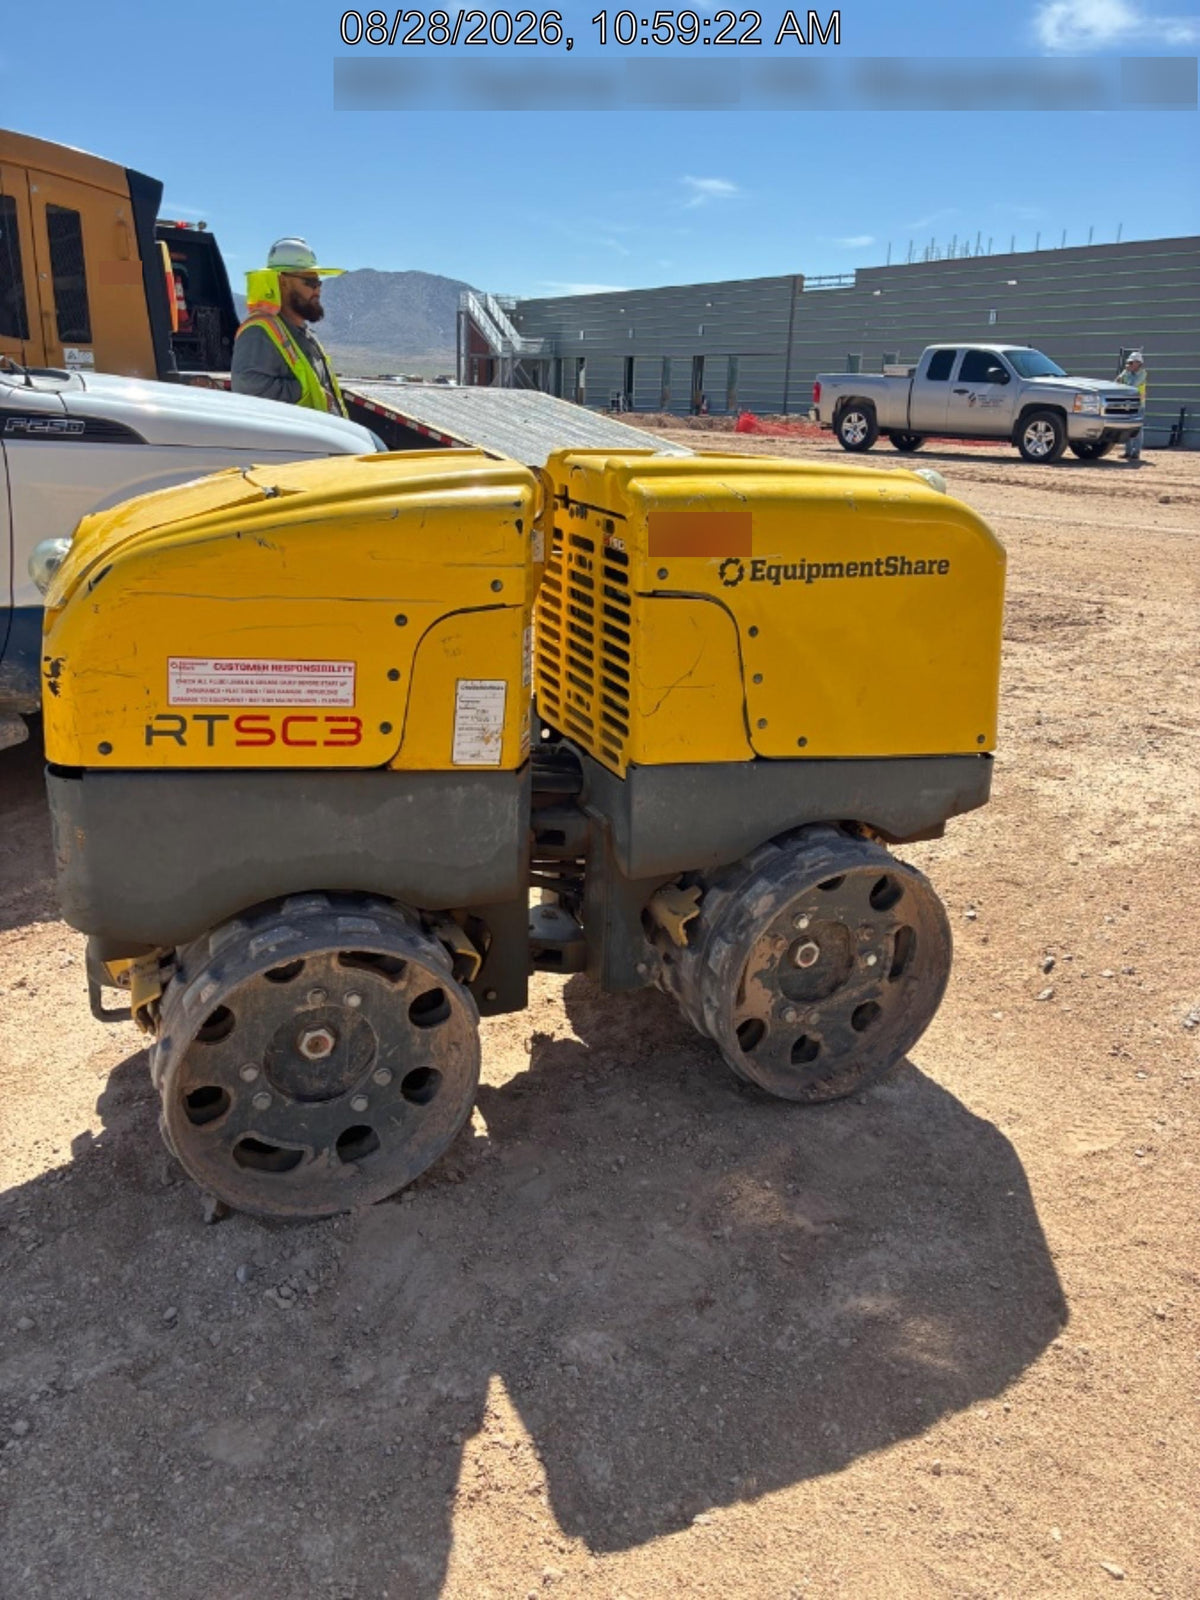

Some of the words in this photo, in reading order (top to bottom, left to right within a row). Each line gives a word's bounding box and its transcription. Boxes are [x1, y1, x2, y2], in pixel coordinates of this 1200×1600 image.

[749, 556, 951, 586] EquipmentShare
[213, 662, 270, 672] CUSTOMER
[271, 663, 354, 673] RESPONSIBILITY
[145, 713, 364, 747] RTSC3
